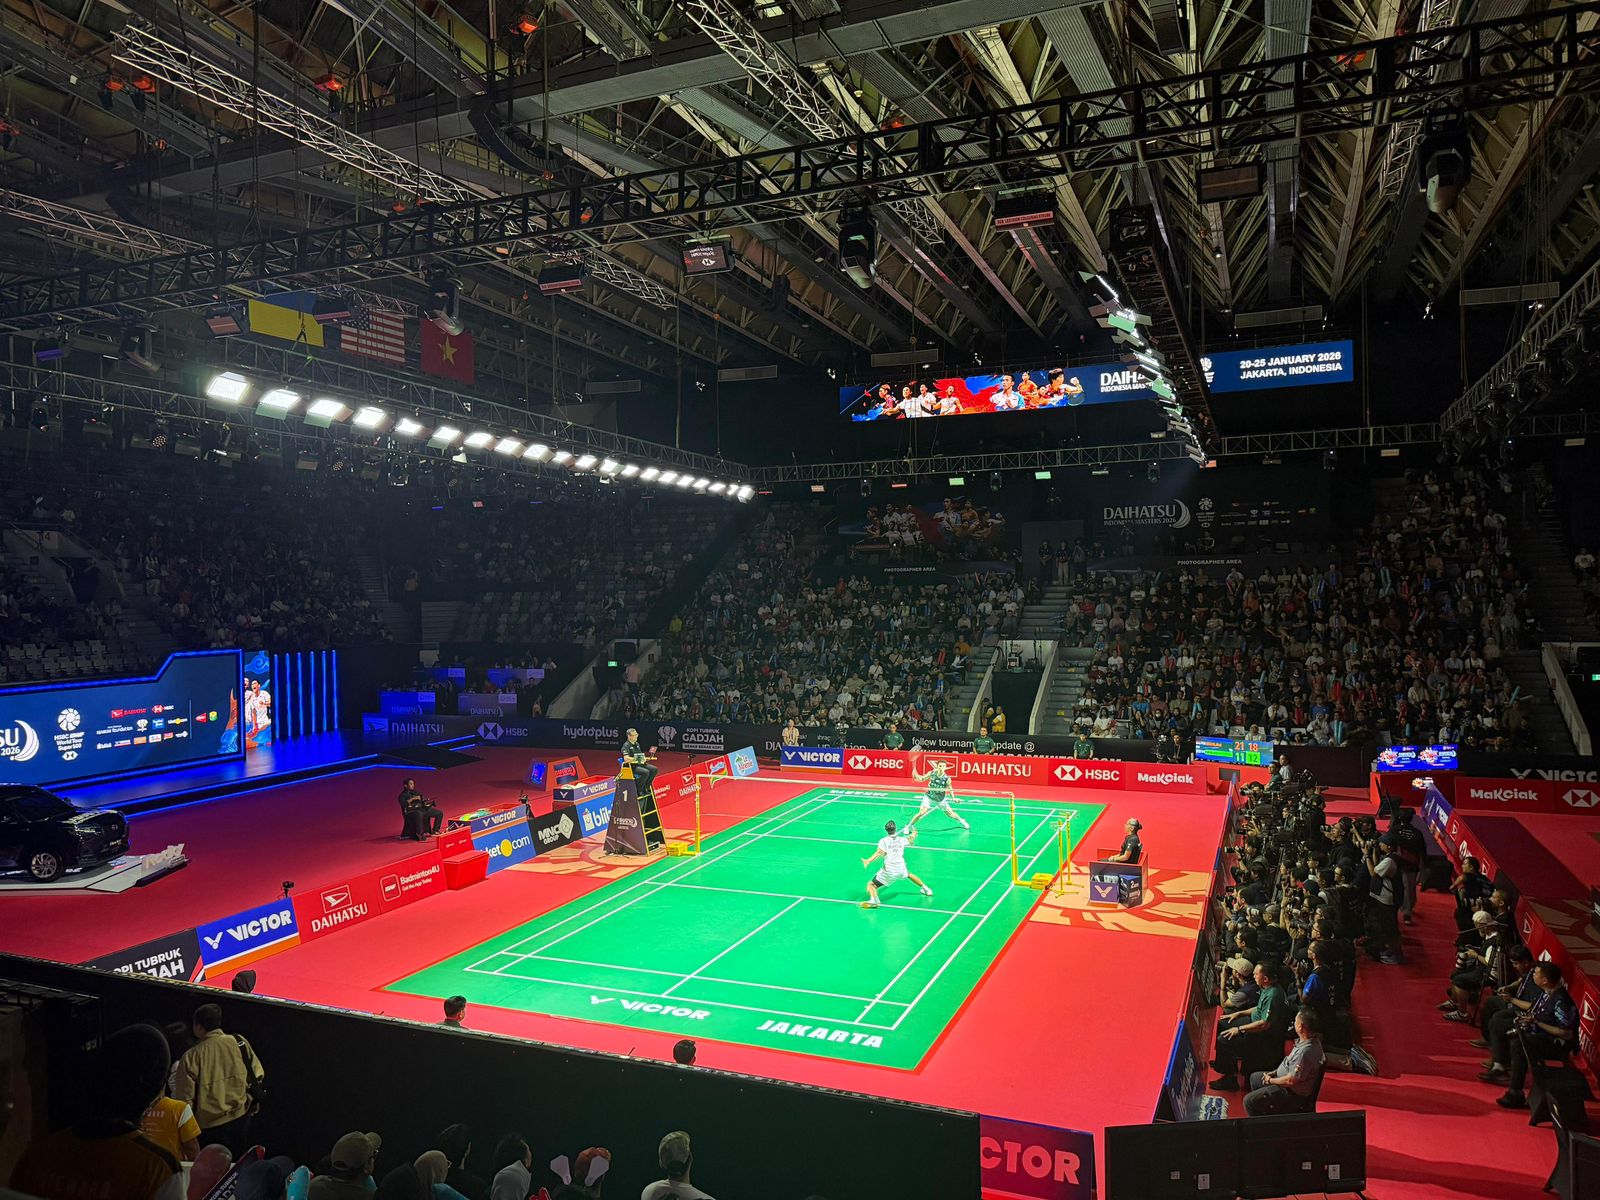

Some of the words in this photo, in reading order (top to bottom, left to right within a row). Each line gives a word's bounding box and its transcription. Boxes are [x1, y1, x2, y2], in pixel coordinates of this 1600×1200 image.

[1240, 359, 1266, 369] 20-25
[1268, 354, 1316, 366] JANUARY
[1318, 351, 1342, 361] 2026
[1240, 368, 1287, 379] JAKARTA,
[1289, 362, 1342, 375] INDONESIA
[1100, 383, 1132, 393] INDONESIA
[1104, 504, 1176, 520] DAIHATSU
[391, 722, 444, 735] DAIHATSU
[505, 727, 528, 737] HSBC
[563, 725, 619, 740] hydroplus
[682, 733, 724, 744] GADJAH
[912, 737, 937, 747] follow
[1, 745, 20, 756] 2026
[1235, 741, 1245, 751] 21
[1248, 742, 1259, 752] 18
[799, 752, 841, 763] VICTOR
[874, 758, 904, 770] HSBC
[1235, 752, 1245, 762] 11
[1249, 754, 1258, 763] 12
[961, 761, 1032, 777] DAIHATSU
[1085, 769, 1120, 781] HSBC
[589, 782, 608, 794] VICTOR
[622, 789, 629, 801] 1
[491, 810, 517, 824] VICTOR
[538, 823, 561, 841] MNC
[543, 834, 560, 845] GROUP
[400, 864, 440, 885] Badminton4U
[311, 902, 368, 933] DAIHATSU
[226, 909, 293, 943] VICTOR
[134, 947, 182, 972] TUBRUK
[620, 998, 712, 1021] VICTOR
[756, 1019, 885, 1048] JAKARTA
